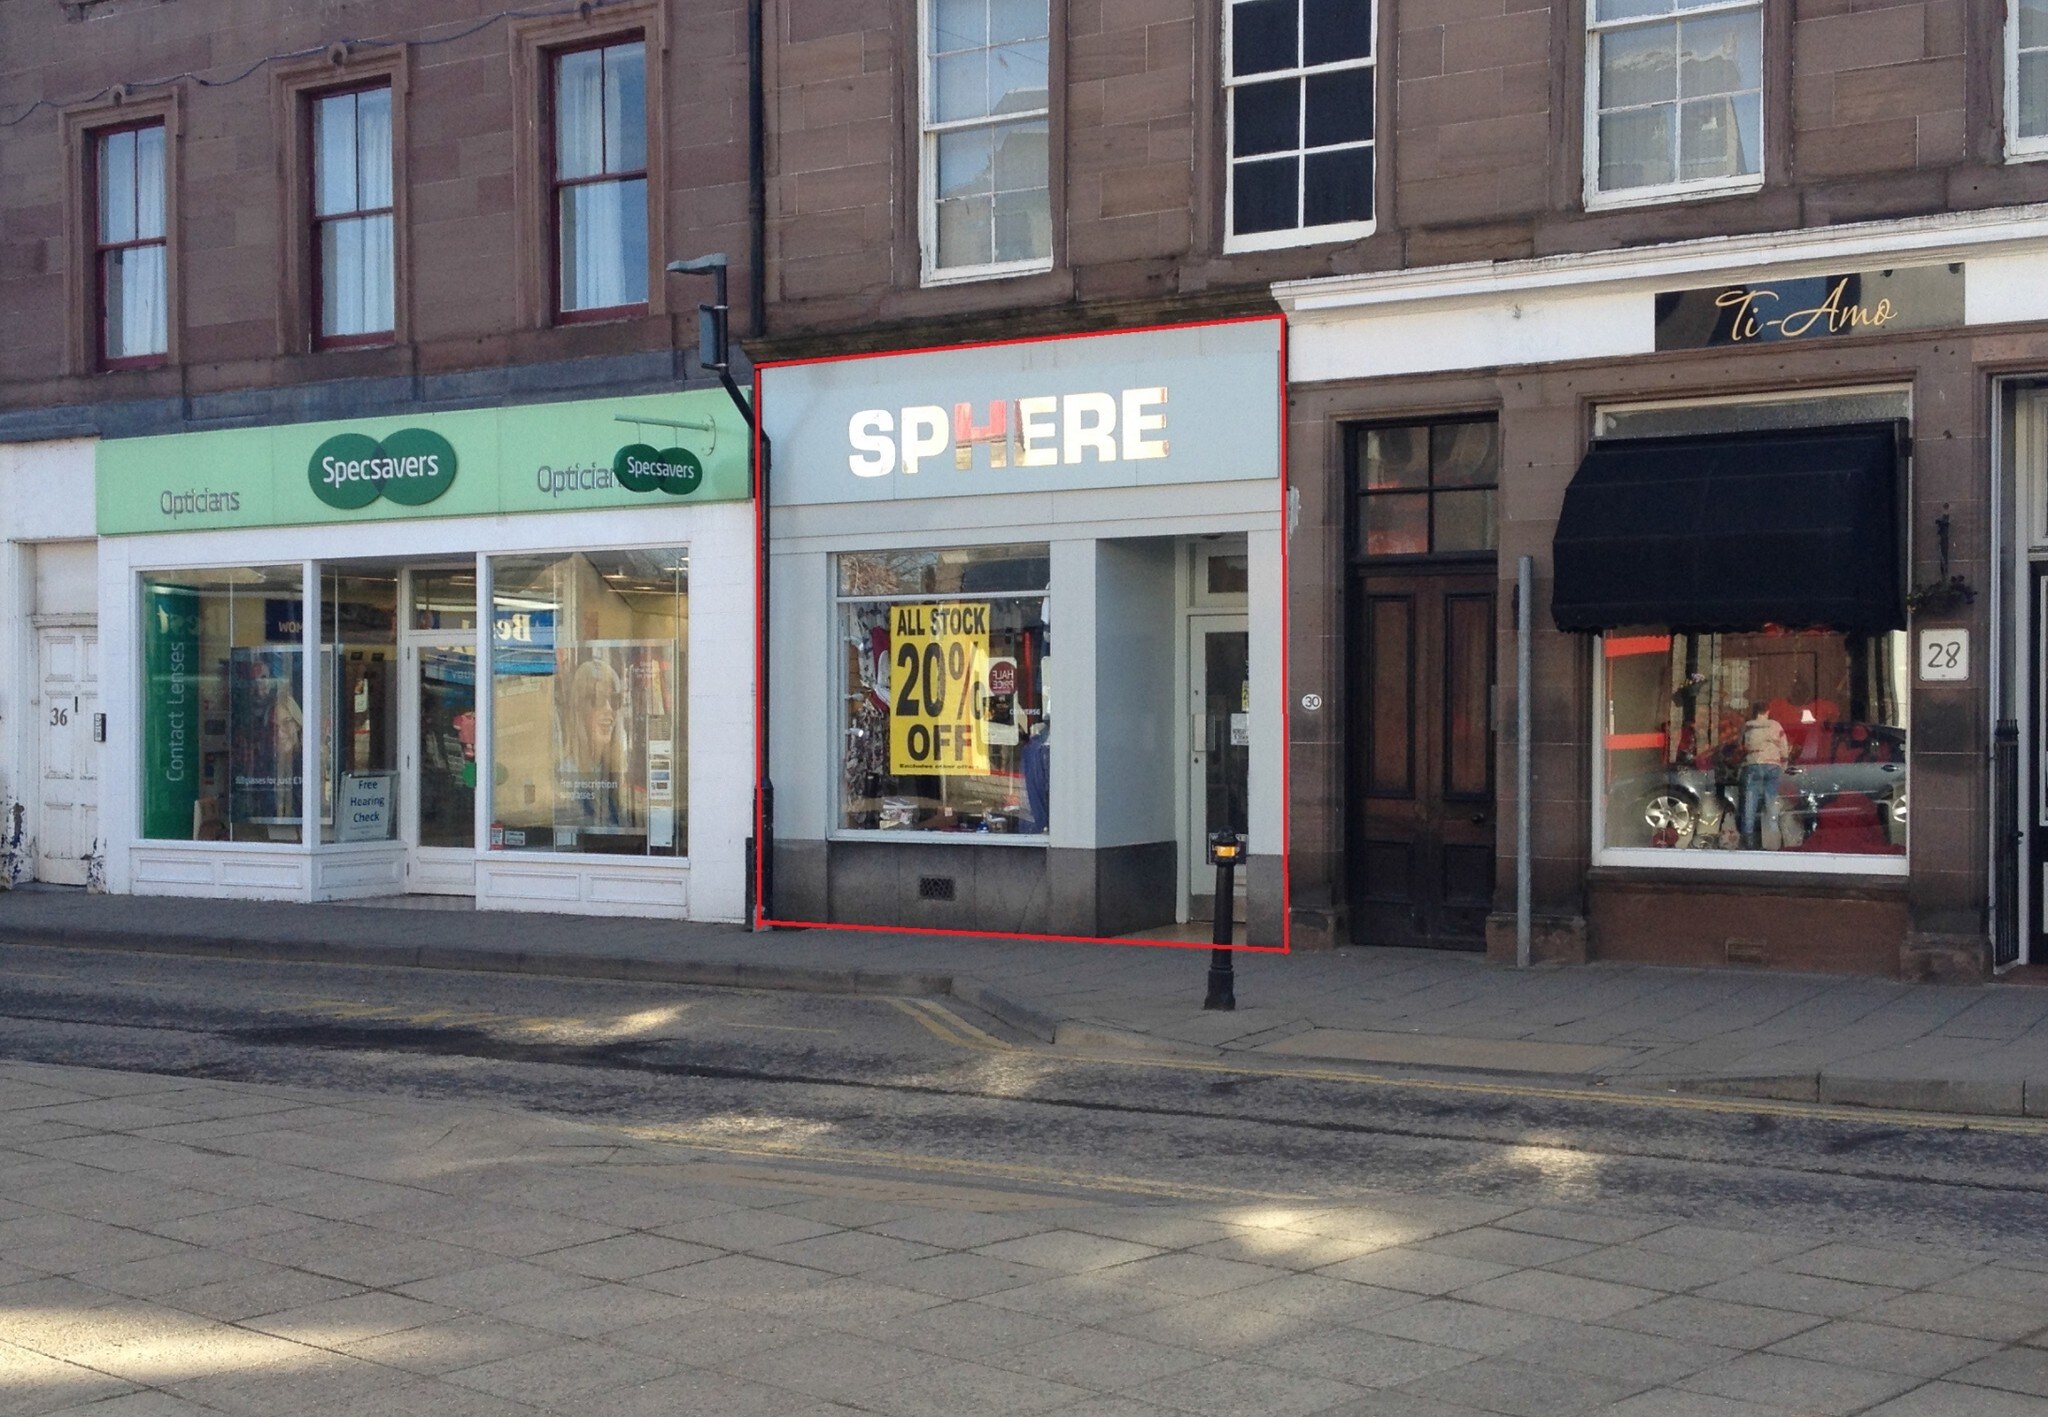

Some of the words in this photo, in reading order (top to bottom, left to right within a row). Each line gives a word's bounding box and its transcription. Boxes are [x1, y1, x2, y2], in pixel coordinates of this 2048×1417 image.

[1715, 277, 1898, 342] Ti-Amo
[848, 387, 1169, 478] SPHERE
[322, 454, 439, 488] Specsavers
[537, 461, 622, 498] Optician
[627, 456, 695, 480] Specsavers
[160, 487, 240, 519] Opticians
[896, 609, 926, 636] ALL
[930, 607, 986, 636] STOCK
[1928, 641, 1961, 669] 28
[167, 641, 185, 705] Lenses
[896, 641, 985, 721] 20%
[50, 707, 68, 727] 36
[1304, 696, 1320, 708] 30
[166, 710, 185, 782] Contact
[907, 724, 973, 762] OFF
[358, 780, 378, 790] Free
[350, 796, 385, 808] Hearing
[353, 811, 380, 823] Check
